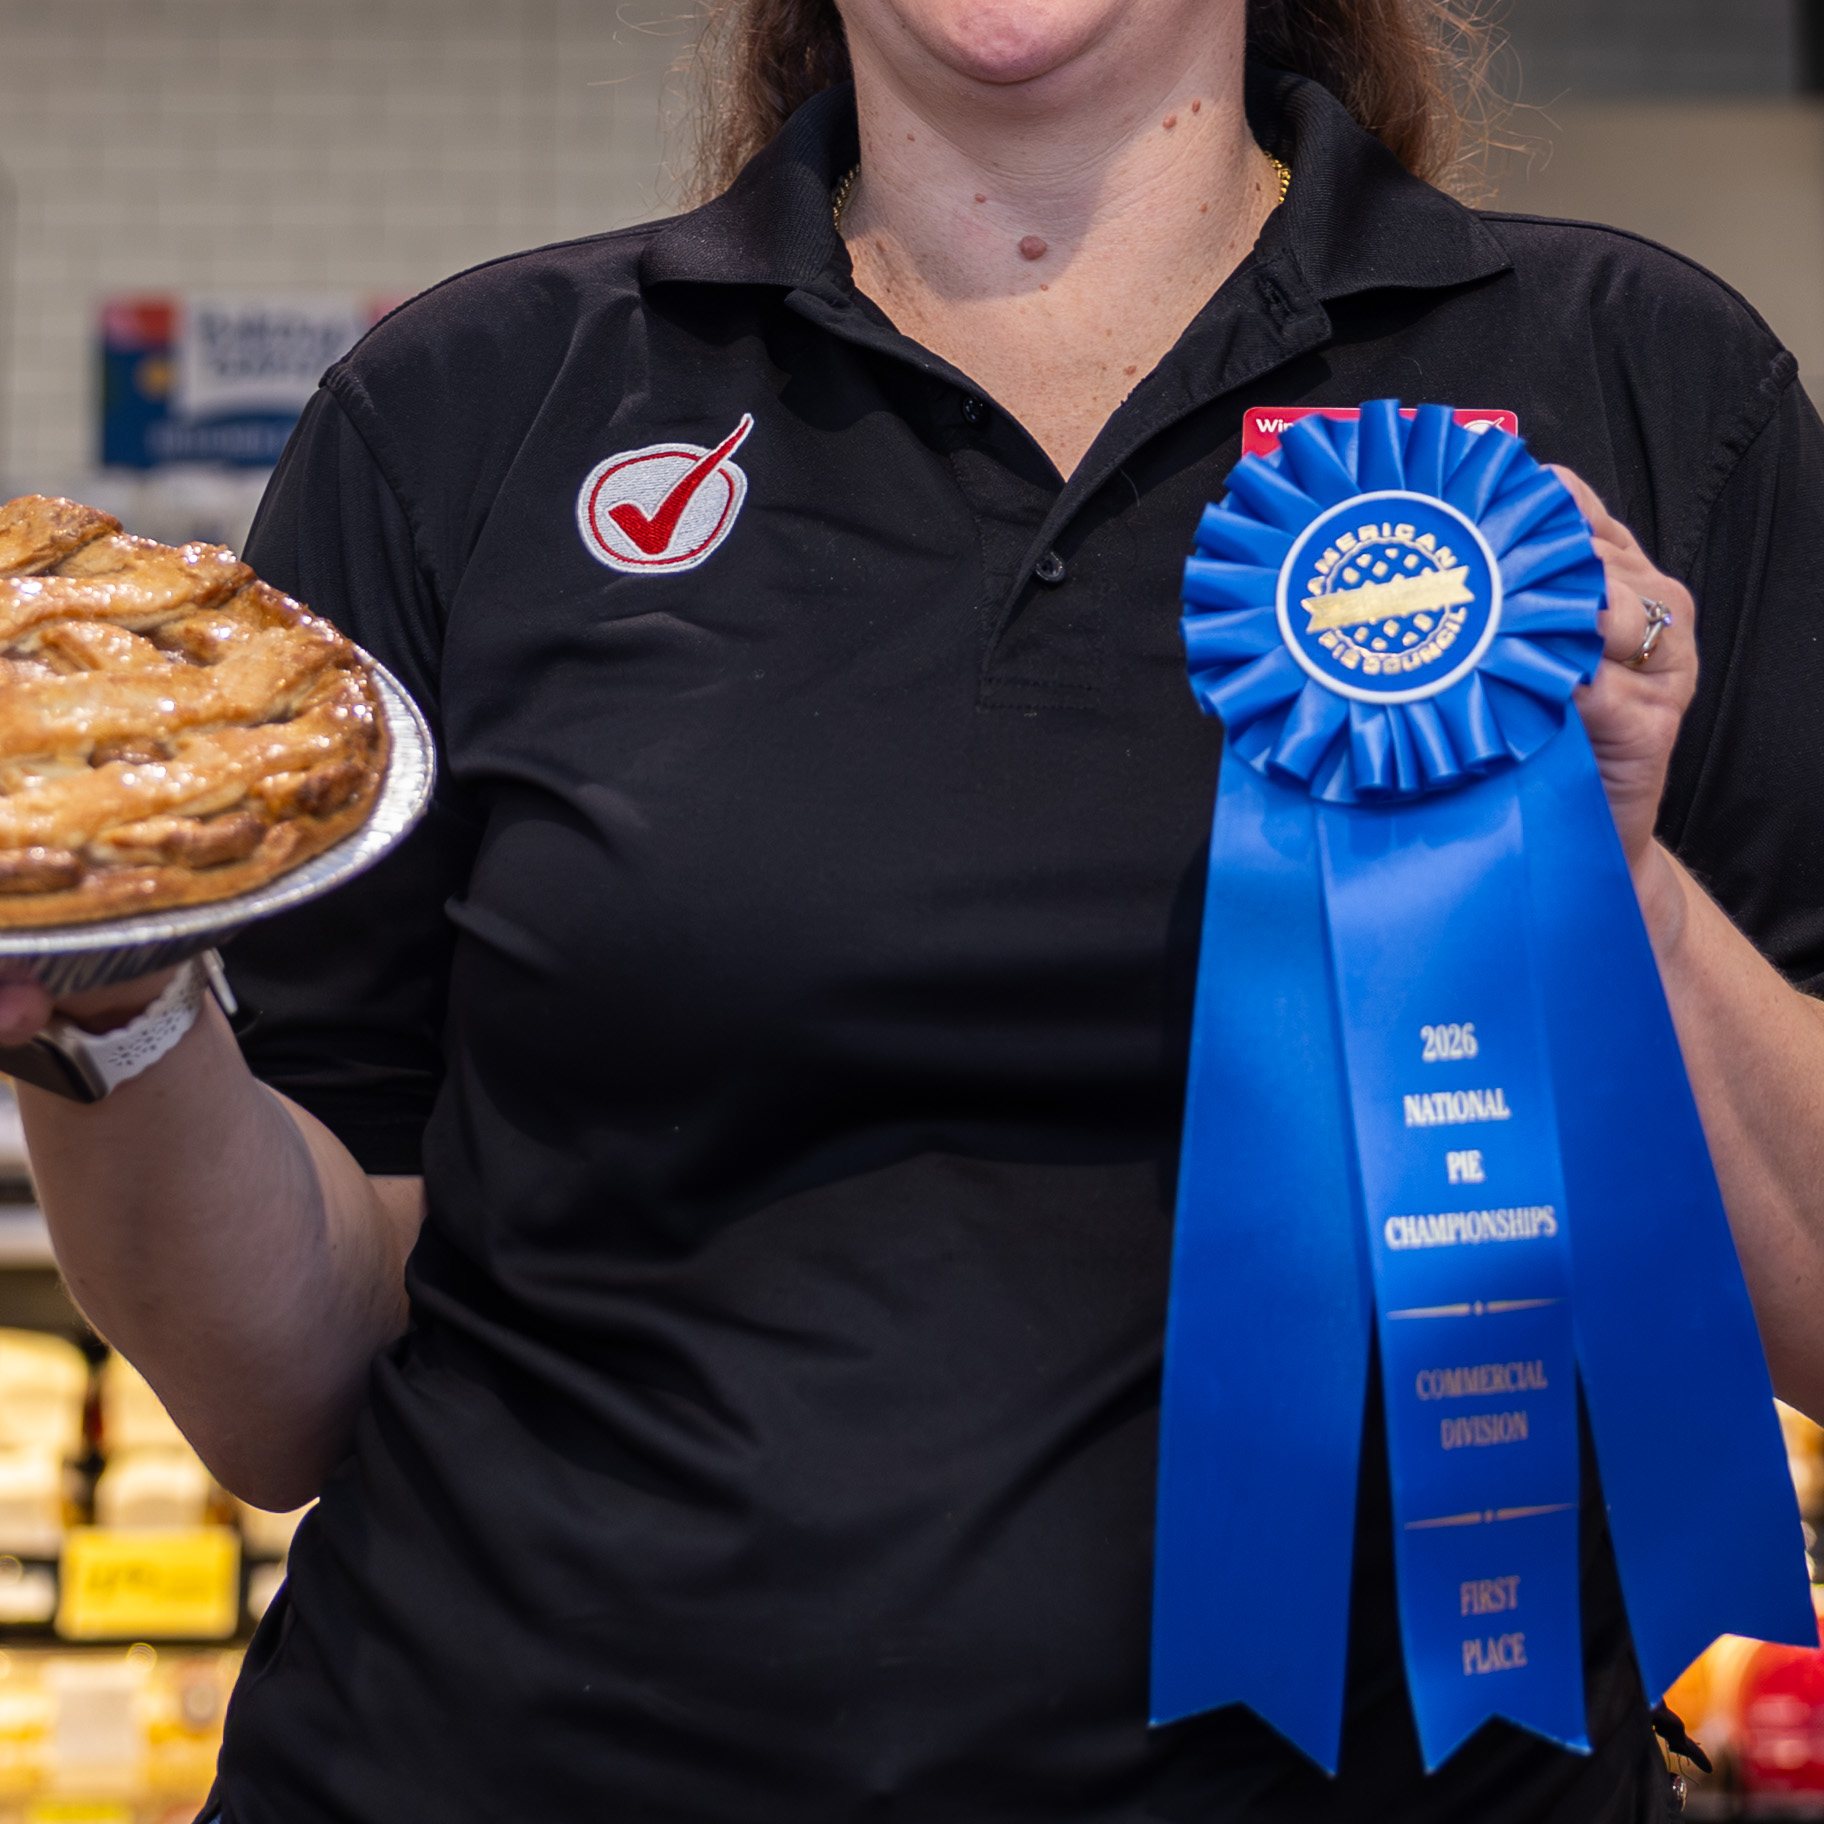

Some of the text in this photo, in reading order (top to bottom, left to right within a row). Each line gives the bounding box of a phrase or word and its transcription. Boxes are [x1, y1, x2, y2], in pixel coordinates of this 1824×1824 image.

[1420, 1023, 1478, 1063] 2026
[1403, 1087, 1511, 1127] NATIONAL
[1446, 1149, 1485, 1184] PIE
[1384, 1205, 1558, 1251] CHAMPIONSHIPS
[1416, 1360, 1548, 1401] COMMERCIAL
[1440, 1410, 1530, 1451] DIVISION
[1460, 1575, 1521, 1617] FIRST
[1462, 1632, 1528, 1676] PLACE
